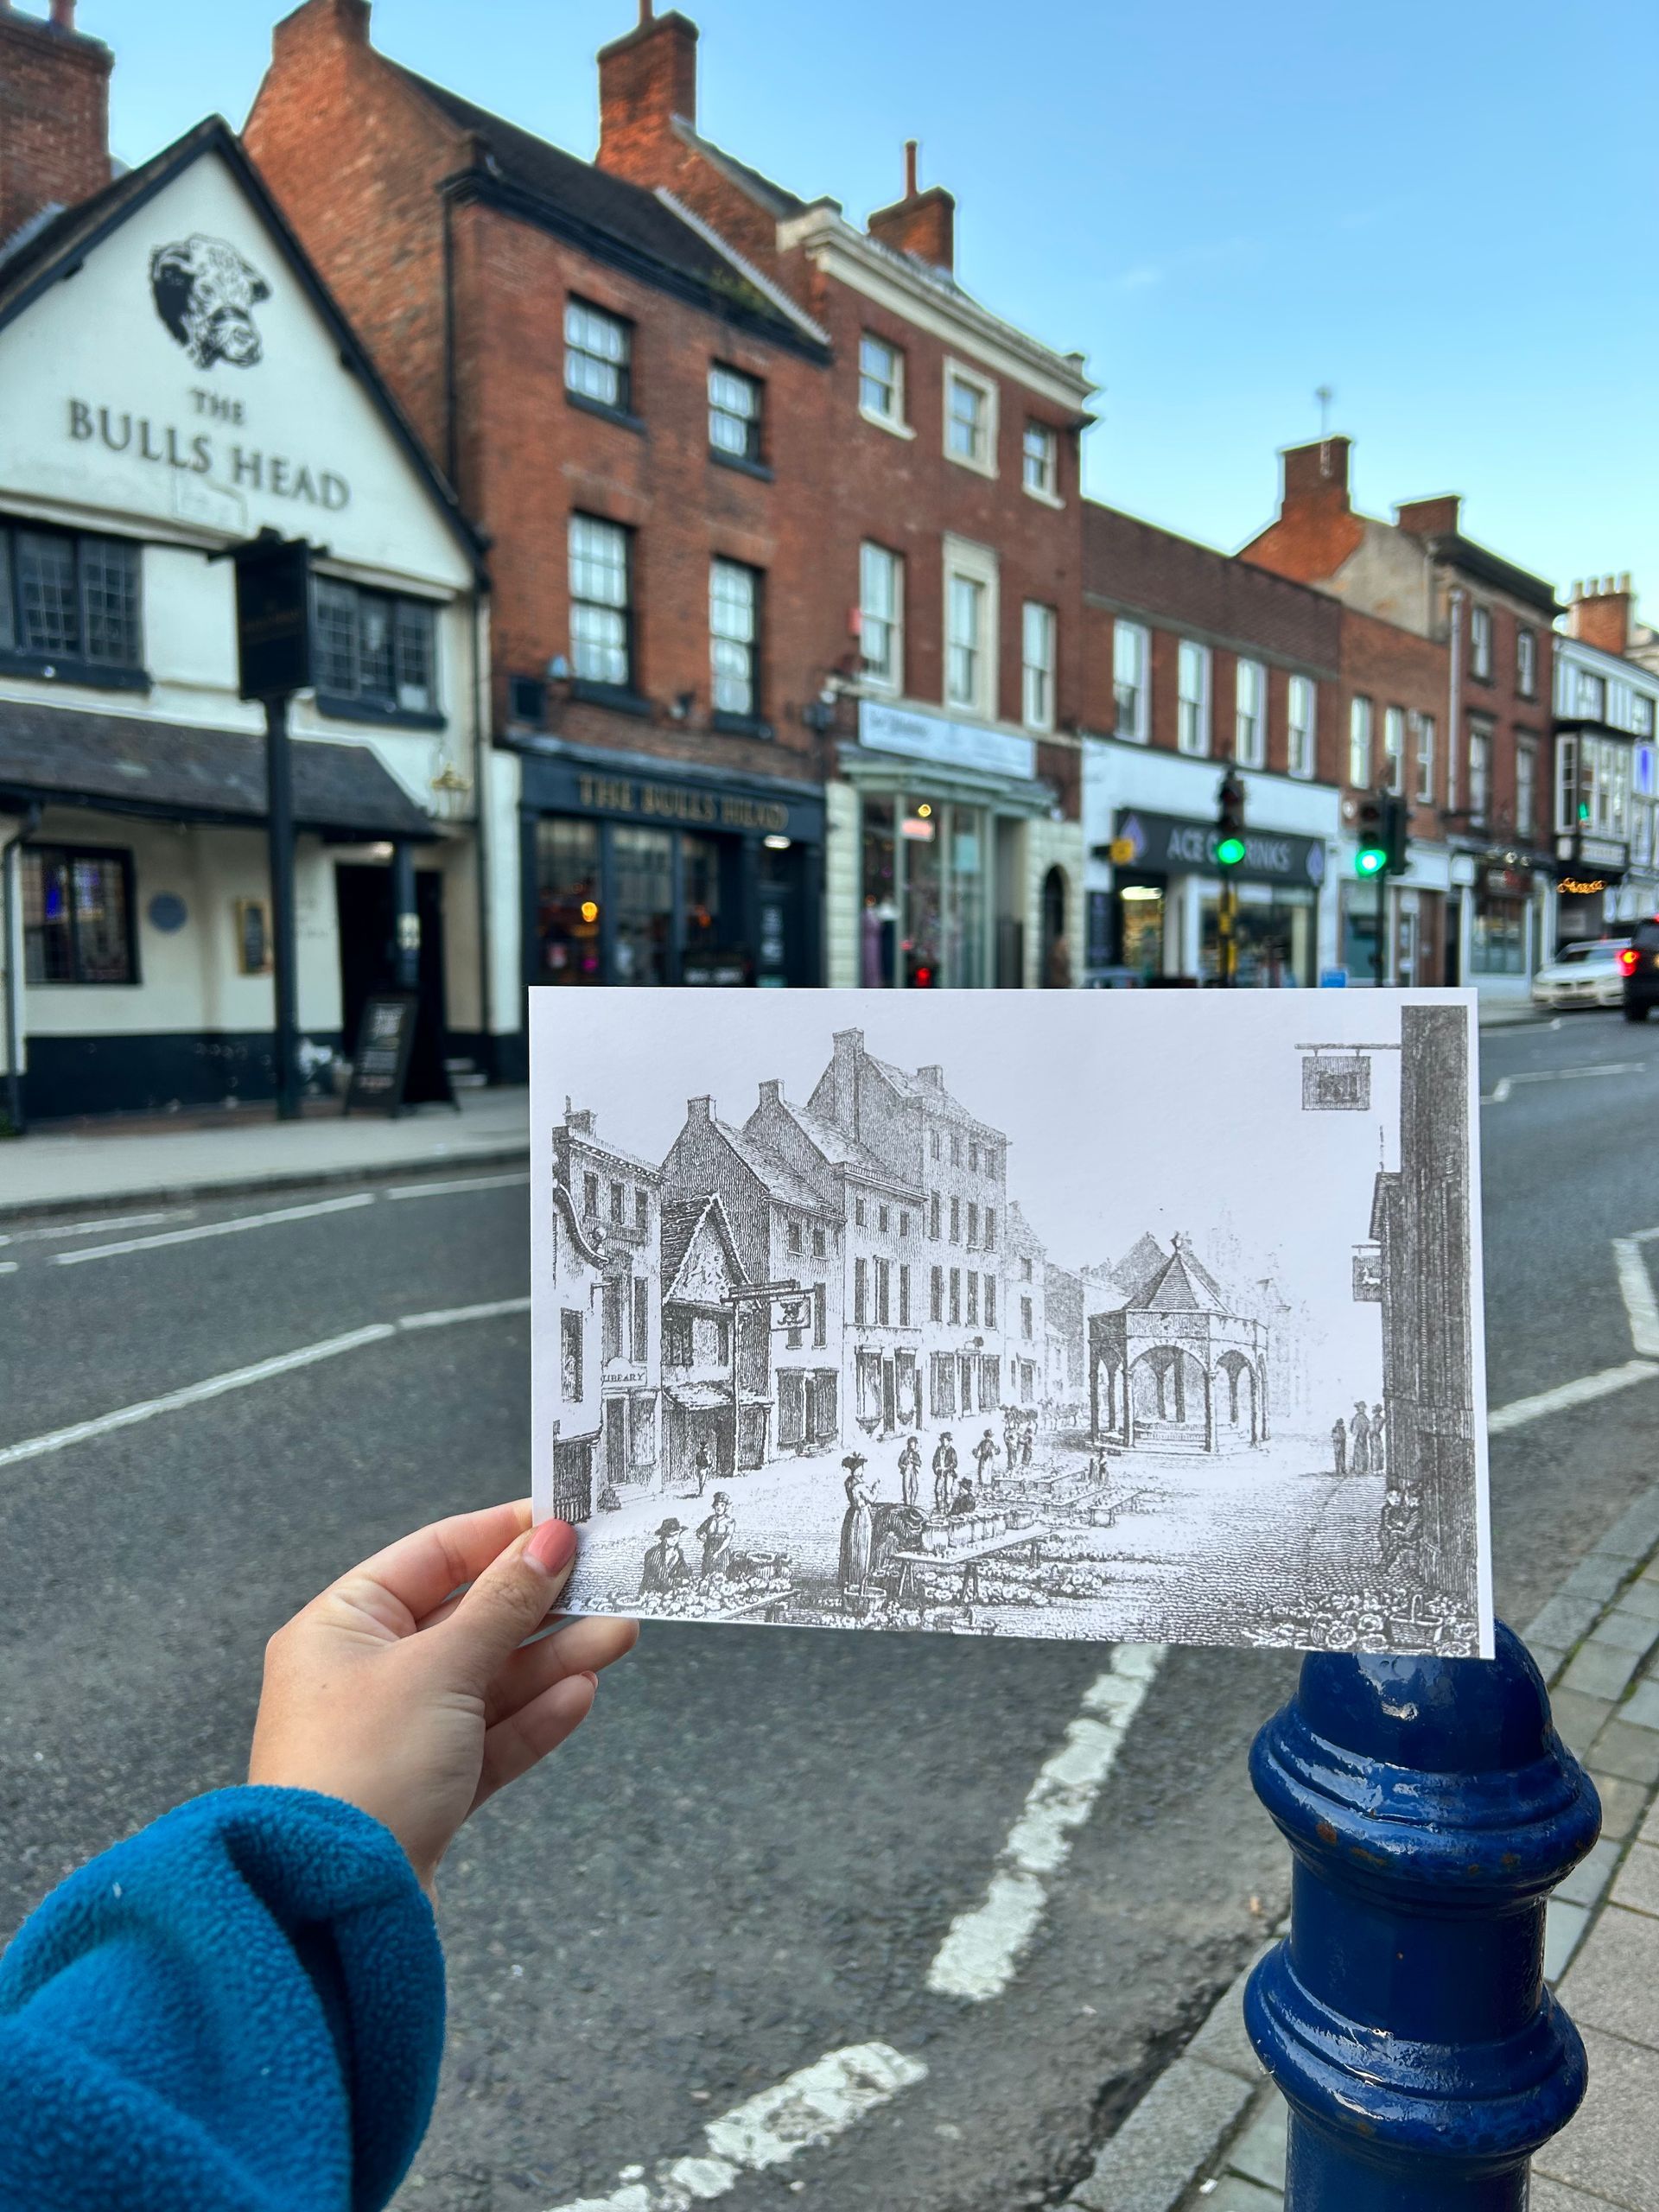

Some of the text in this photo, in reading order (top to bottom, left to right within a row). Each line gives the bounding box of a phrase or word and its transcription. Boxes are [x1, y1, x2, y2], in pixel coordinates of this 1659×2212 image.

[191, 389, 245, 425] THE
[69, 397, 350, 511] BULLS HEAD
[579, 773, 632, 811] THE
[642, 784, 716, 821] BULLS
[1168, 829, 1203, 862] ACE
[1244, 837, 1290, 872] RINKS
